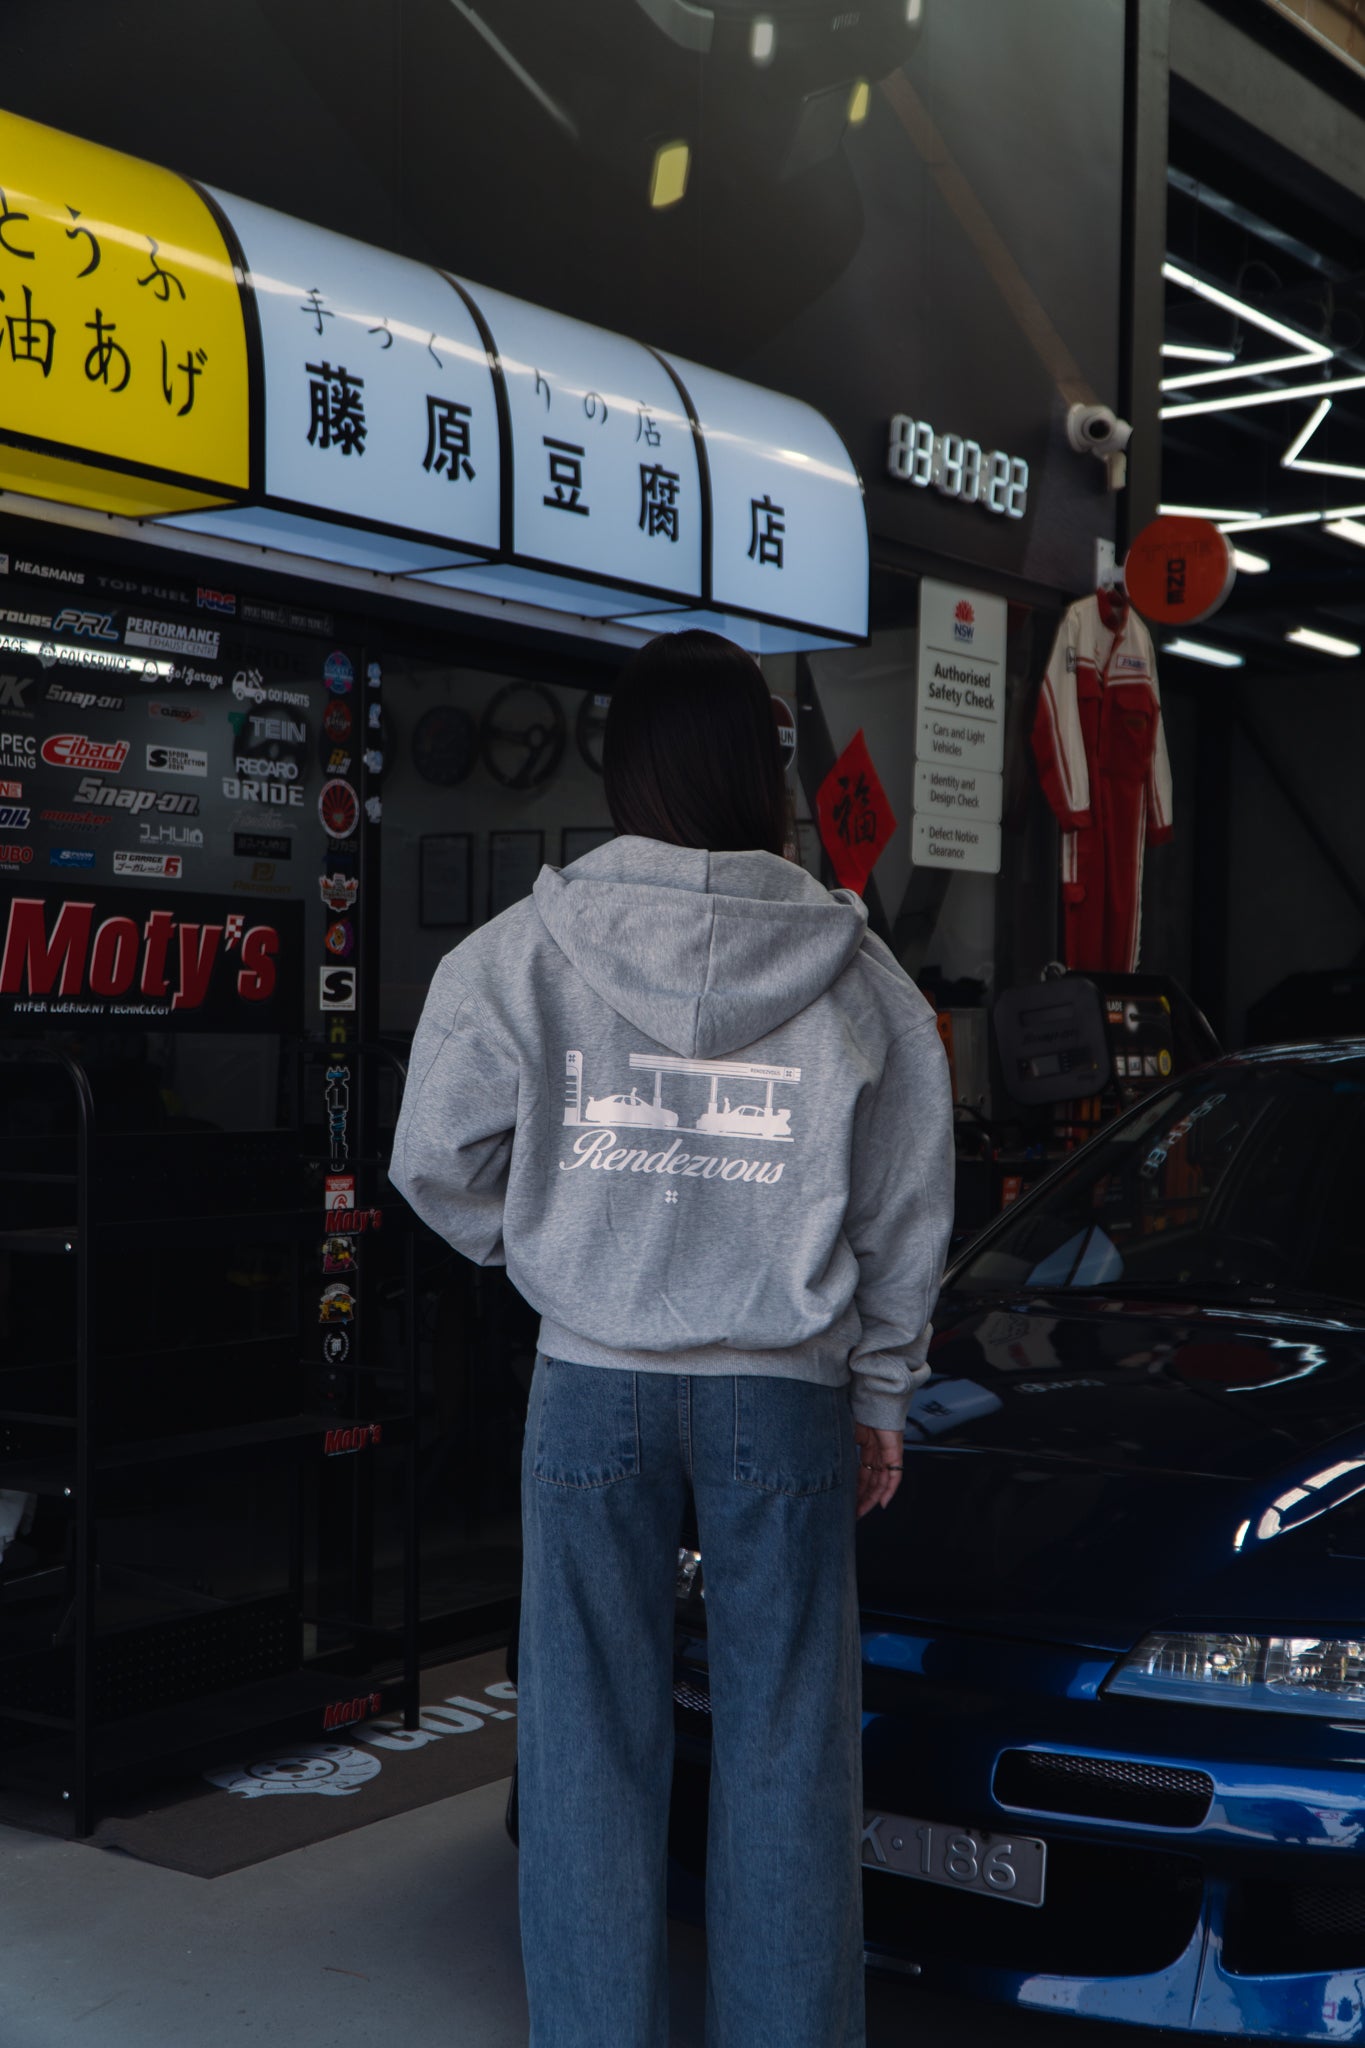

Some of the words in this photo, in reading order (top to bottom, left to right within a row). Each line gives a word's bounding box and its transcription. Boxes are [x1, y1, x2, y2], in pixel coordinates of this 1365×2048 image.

[305, 361, 785, 568] 藤原豆腐店
[15, 560, 86, 585] HEASMANS
[97, 576, 138, 592] TOP
[126, 616, 221, 645] PERFORMANCE
[954, 622, 975, 639] NSW
[934, 663, 991, 689] Authorised
[929, 681, 962, 707] Safety
[965, 690, 995, 710] Check
[249, 715, 306, 743] TEIN
[933, 723, 949, 737] Cars
[951, 727, 966, 740] and
[967, 729, 985, 746] Light
[933, 739, 962, 756] Vehicles
[0, 754, 37, 770] ILING
[235, 756, 299, 780] RECARO
[222, 777, 304, 807] BRIDE
[930, 773, 959, 791] Identity
[960, 778, 976, 791] and
[73, 777, 199, 816] Snap-on
[930, 789, 955, 808] Design
[957, 793, 979, 808] Check
[40, 809, 113, 825] monster
[929, 826, 953, 841] Defect
[955, 829, 979, 845] Notice
[928, 843, 966, 859] Clearance
[0, 897, 280, 1011] Moty's
[559, 1129, 785, 1184] Rendezvous
[325, 1207, 383, 1233] Moty's
[324, 1423, 383, 1451] Moty's
[323, 1693, 382, 1727] Moty's
